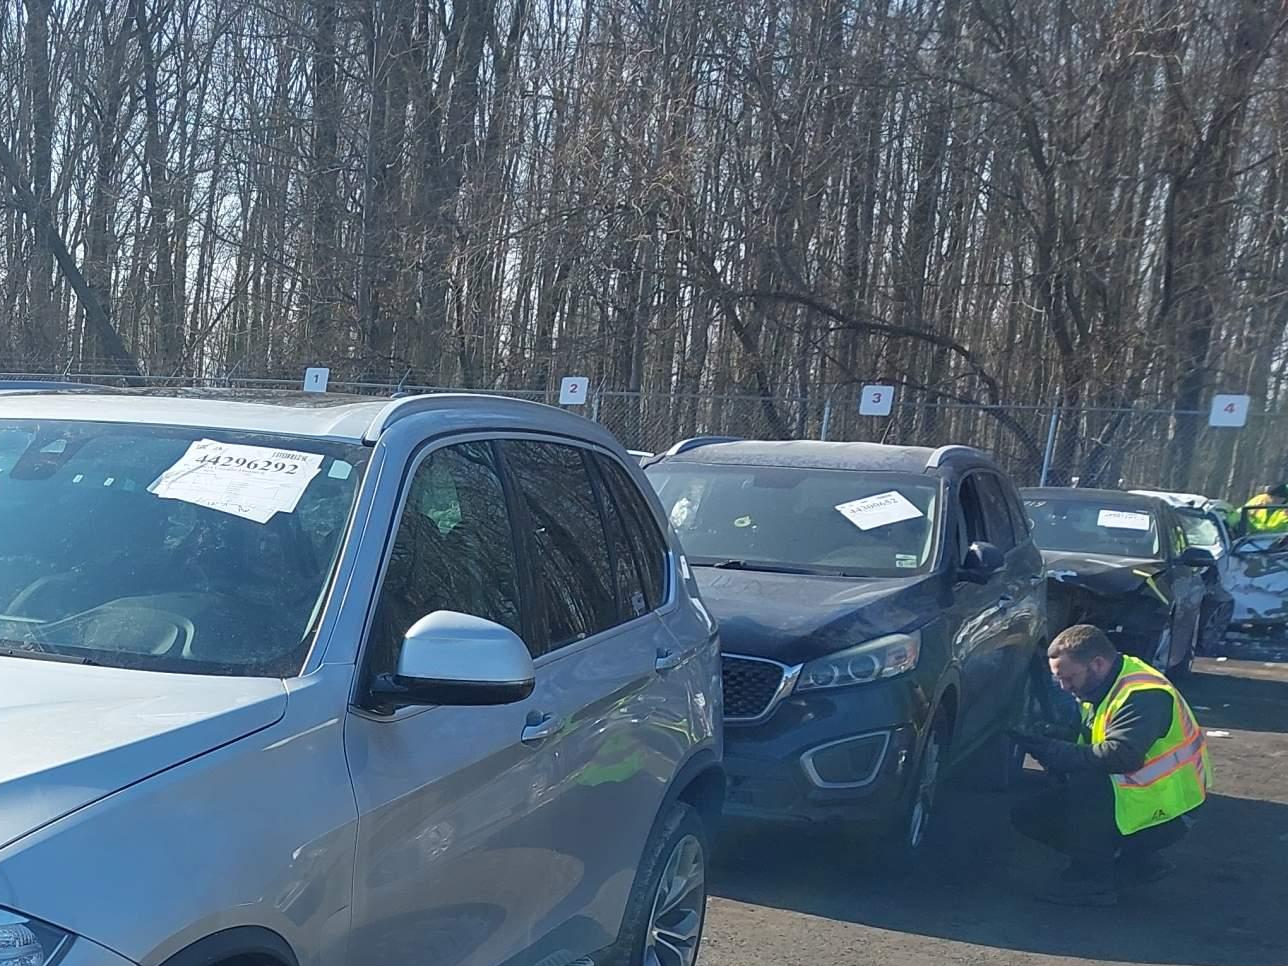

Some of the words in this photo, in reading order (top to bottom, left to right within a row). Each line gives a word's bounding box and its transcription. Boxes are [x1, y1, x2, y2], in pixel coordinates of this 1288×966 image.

[313, 374, 320, 384] 1
[569, 383, 578, 394] 2
[871, 392, 882, 404] 3
[1223, 402, 1235, 414] 4
[195, 453, 299, 475] 44296292
